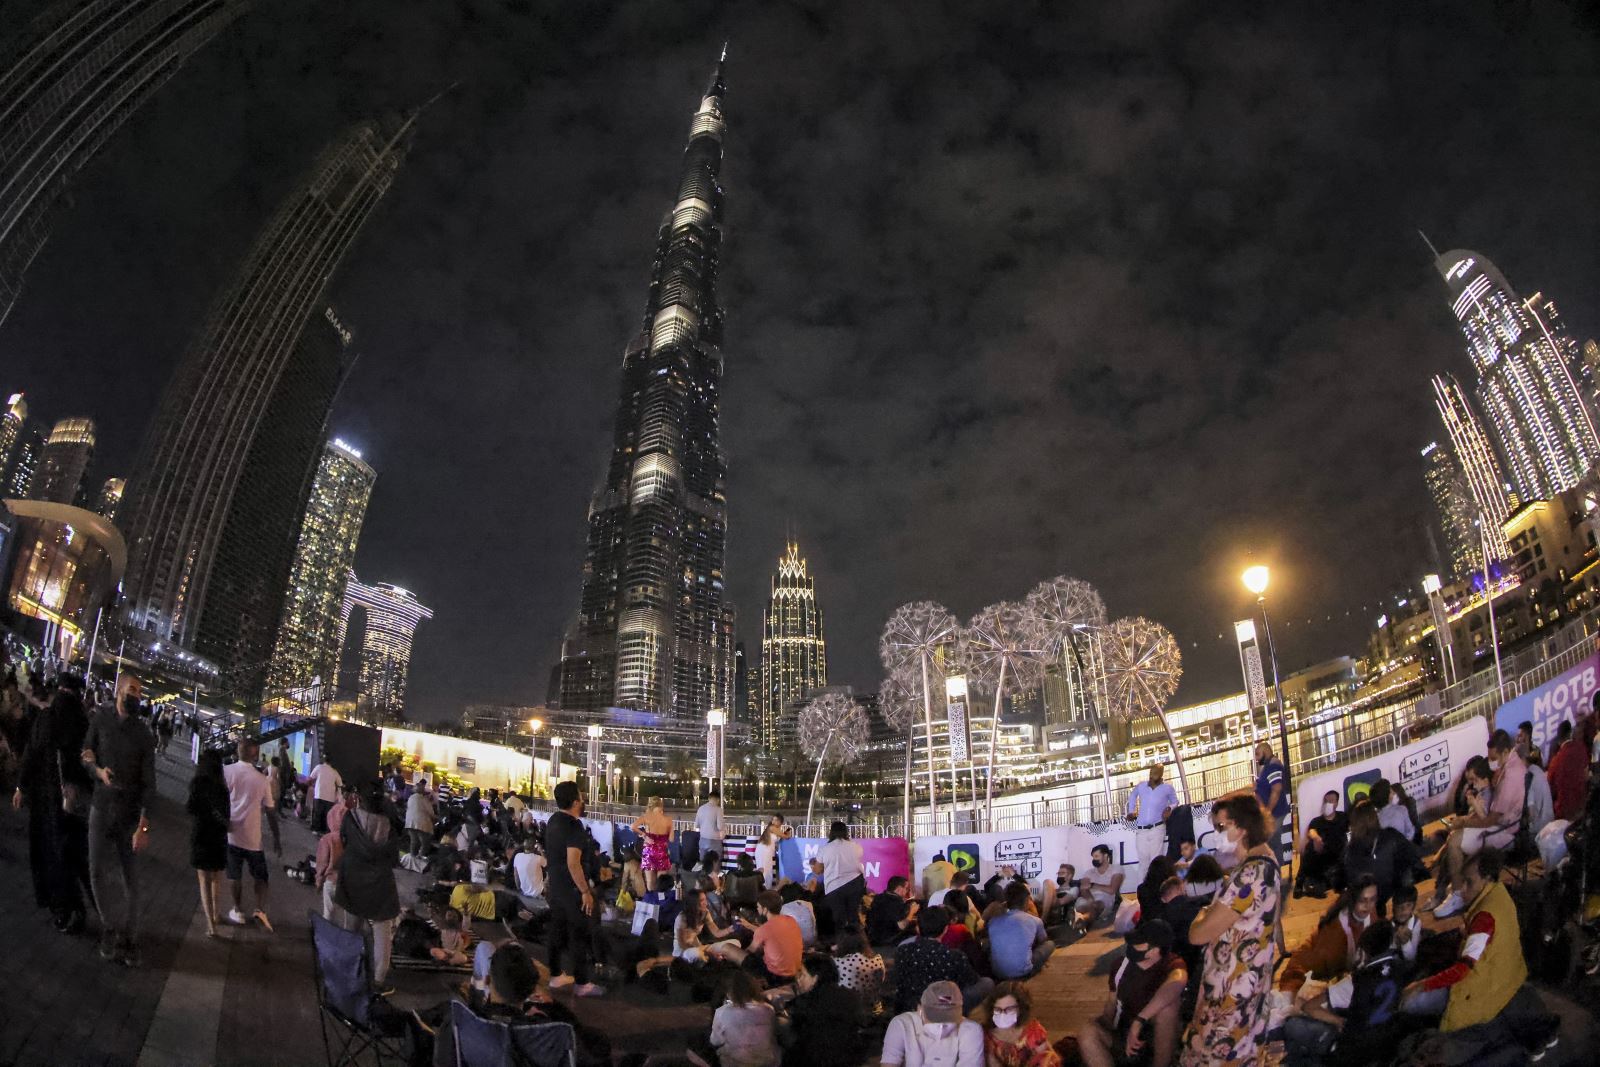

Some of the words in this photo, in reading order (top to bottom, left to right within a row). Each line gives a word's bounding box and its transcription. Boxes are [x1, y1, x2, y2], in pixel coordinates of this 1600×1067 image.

[324, 307, 352, 345] EMAAR
[1533, 666, 1597, 721] MOTB
[1409, 748, 1443, 768] MOT
[1439, 772, 1446, 780] B
[1004, 841, 1036, 851] MOT
[1031, 861, 1038, 869] B
[1369, 978, 1397, 1025] 2
